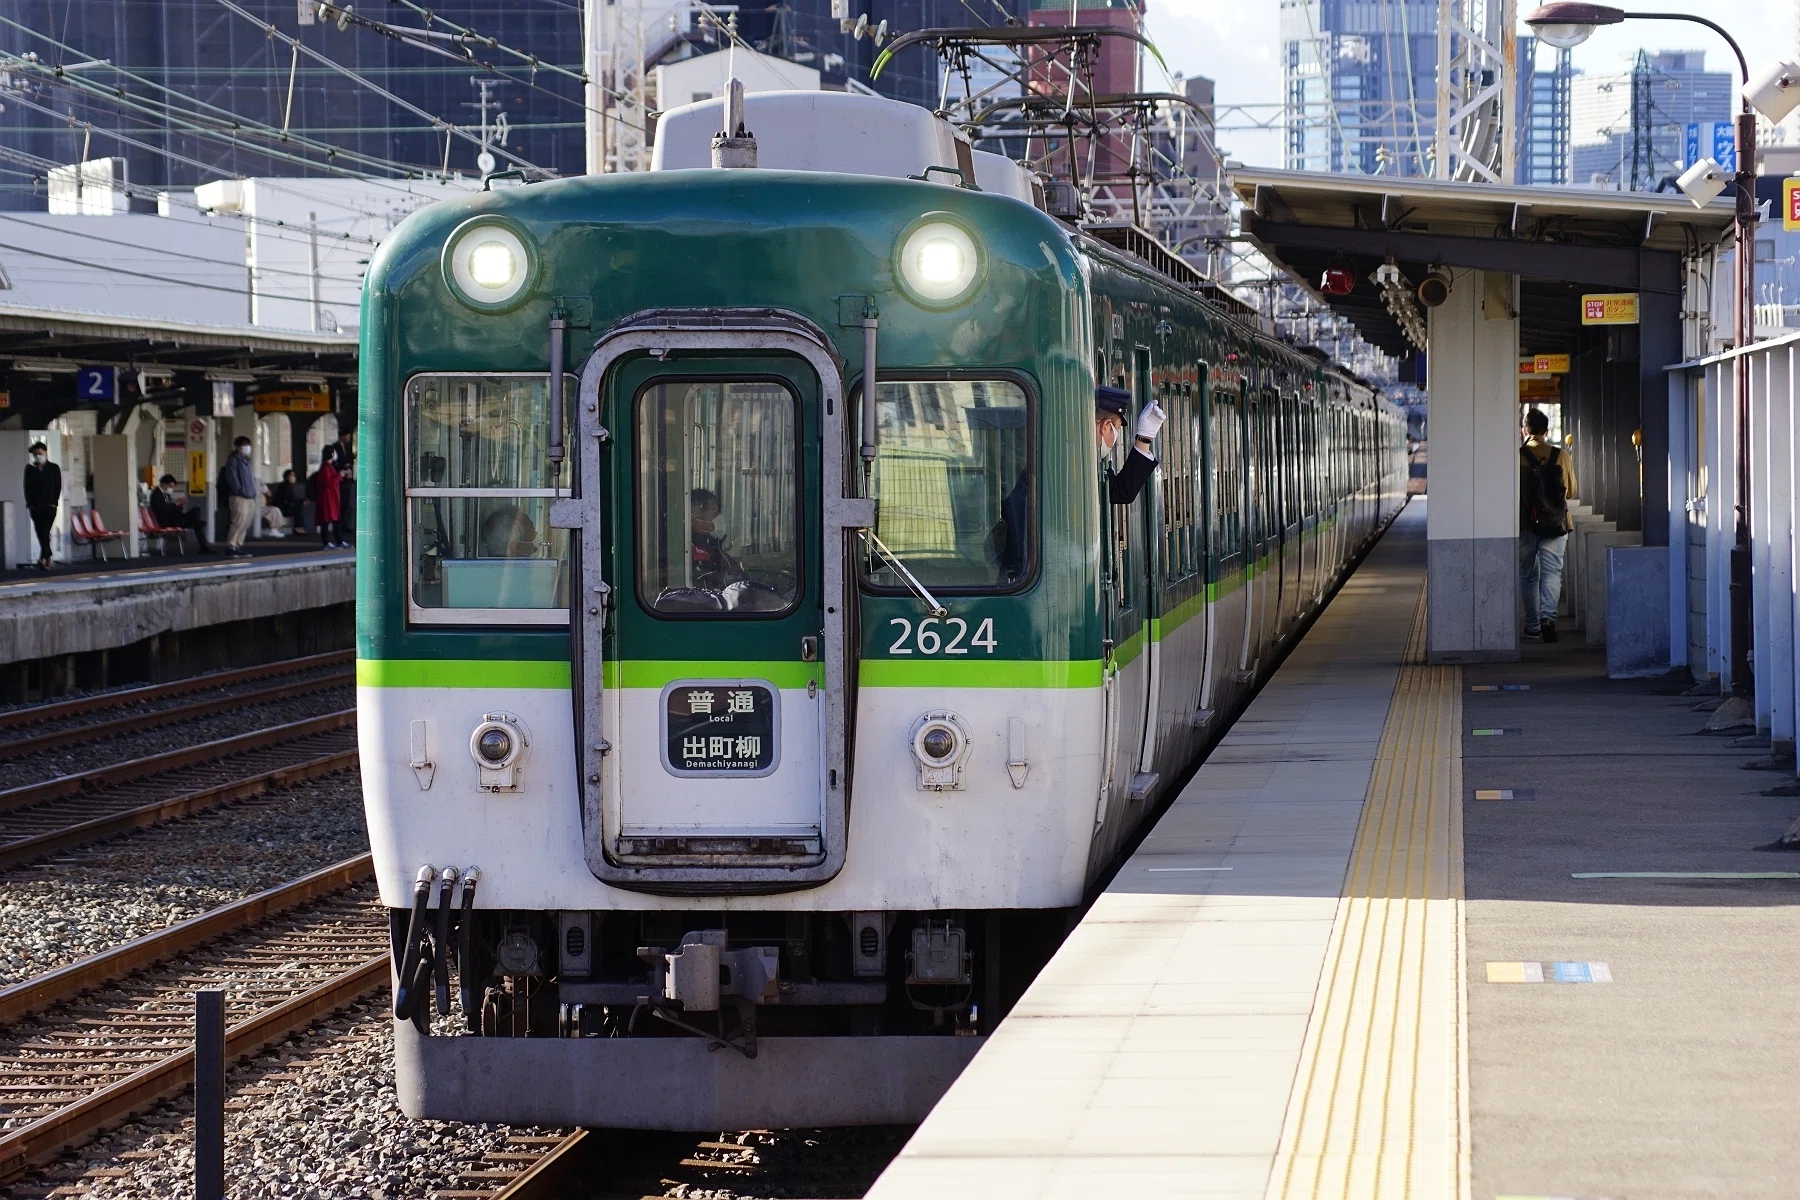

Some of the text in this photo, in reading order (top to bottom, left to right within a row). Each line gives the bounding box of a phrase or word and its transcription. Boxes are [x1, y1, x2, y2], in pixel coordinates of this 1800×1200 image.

[88, 371, 103, 394] 2
[889, 617, 998, 655] 2624
[687, 690, 755, 714] 普通
[709, 715, 734, 723] Local
[683, 735, 761, 759] 出町柳
[686, 760, 758, 769] Demachiyanagi
